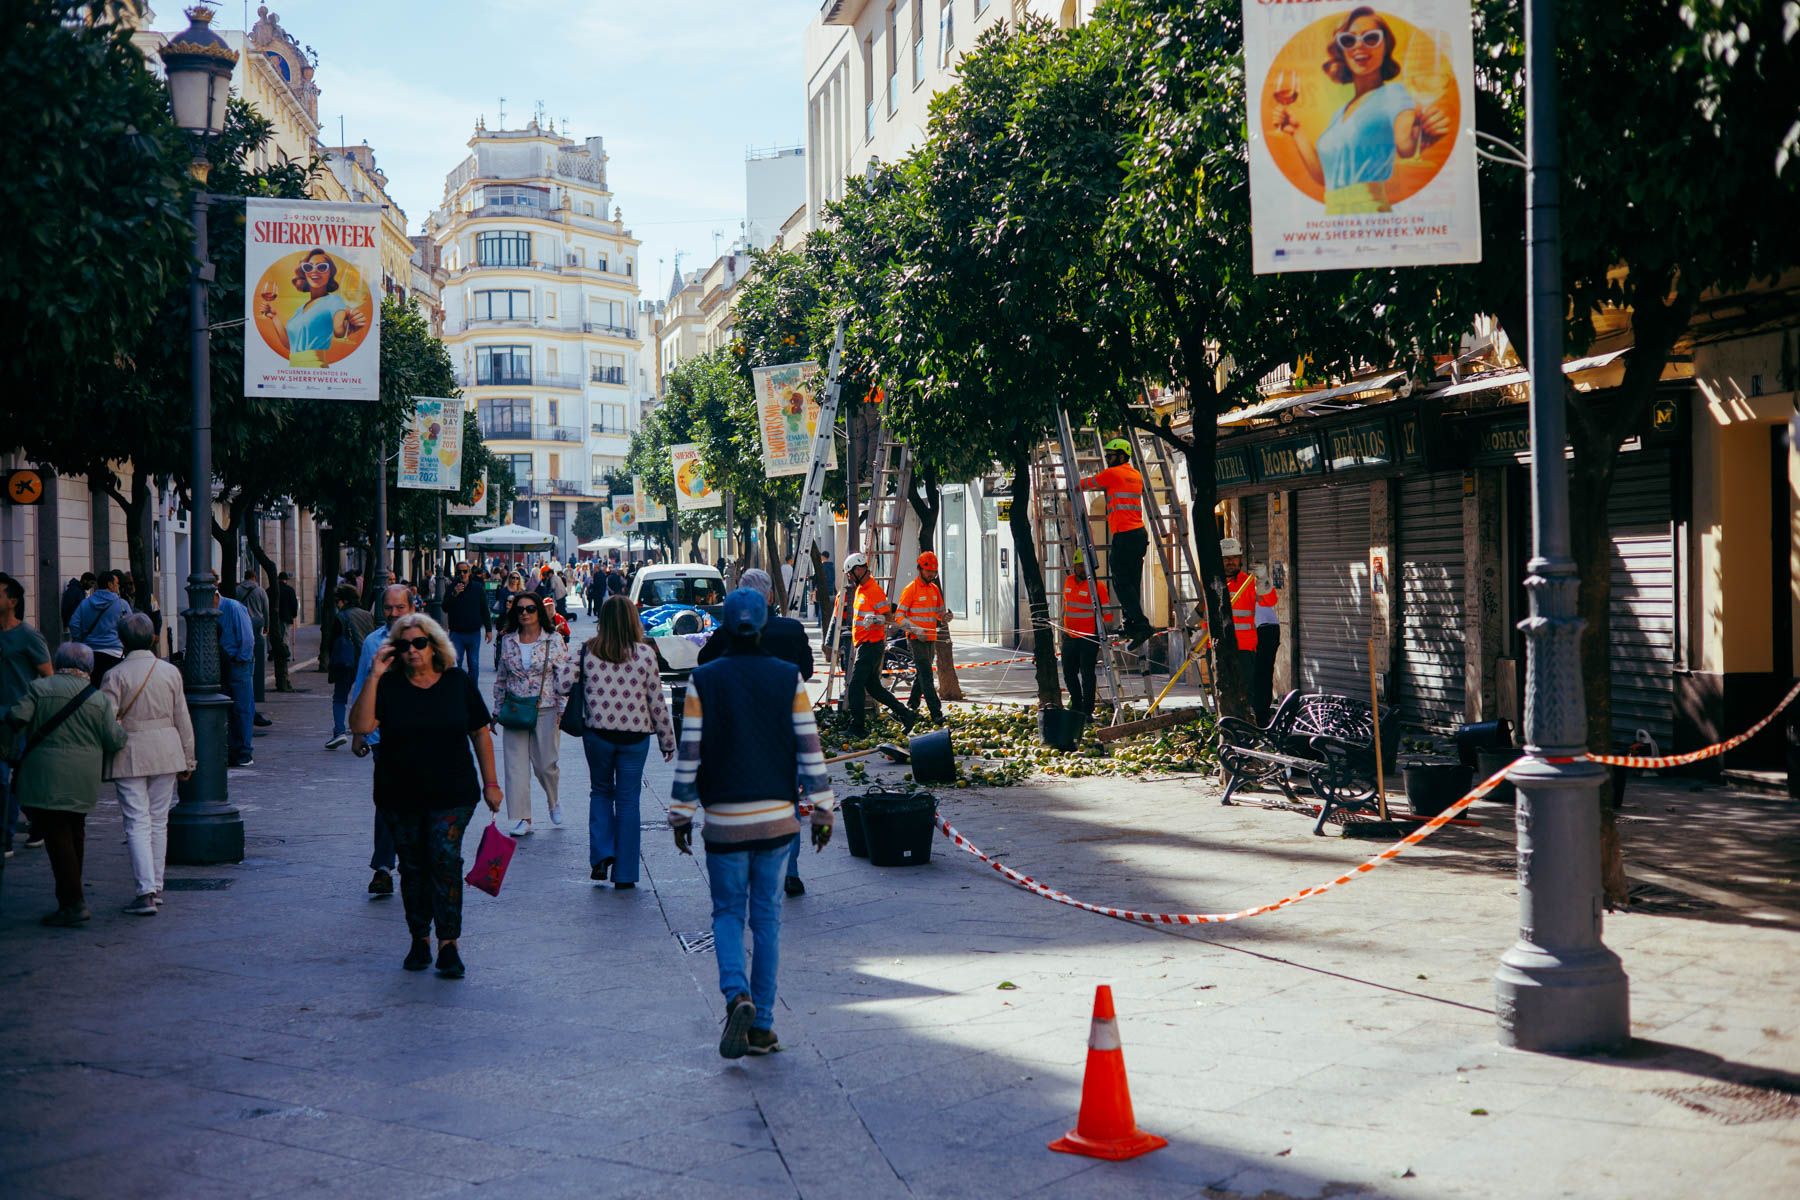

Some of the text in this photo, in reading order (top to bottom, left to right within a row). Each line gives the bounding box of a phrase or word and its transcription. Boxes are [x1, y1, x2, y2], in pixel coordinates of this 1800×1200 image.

[325, 215, 346, 223] 2025
[1306, 215, 1425, 229] ENCUENTRA EVENTOS EN
[1283, 224, 1449, 242] WWW.SHERRYWEEK.WINE
[262, 374, 363, 384] WWW.SHERRYWEEK.WINE
[1656, 408, 1672, 424] M
[403, 429, 419, 474] ENOTURISM
[442, 441, 457, 449] 2025
[1215, 455, 1247, 480] OYERIA
[1333, 429, 1386, 460] REGALOS
[1403, 422, 1416, 454] 17
[674, 450, 699, 460] SHERRY
[789, 452, 811, 466] 2025
[419, 472, 438, 482] 2025
